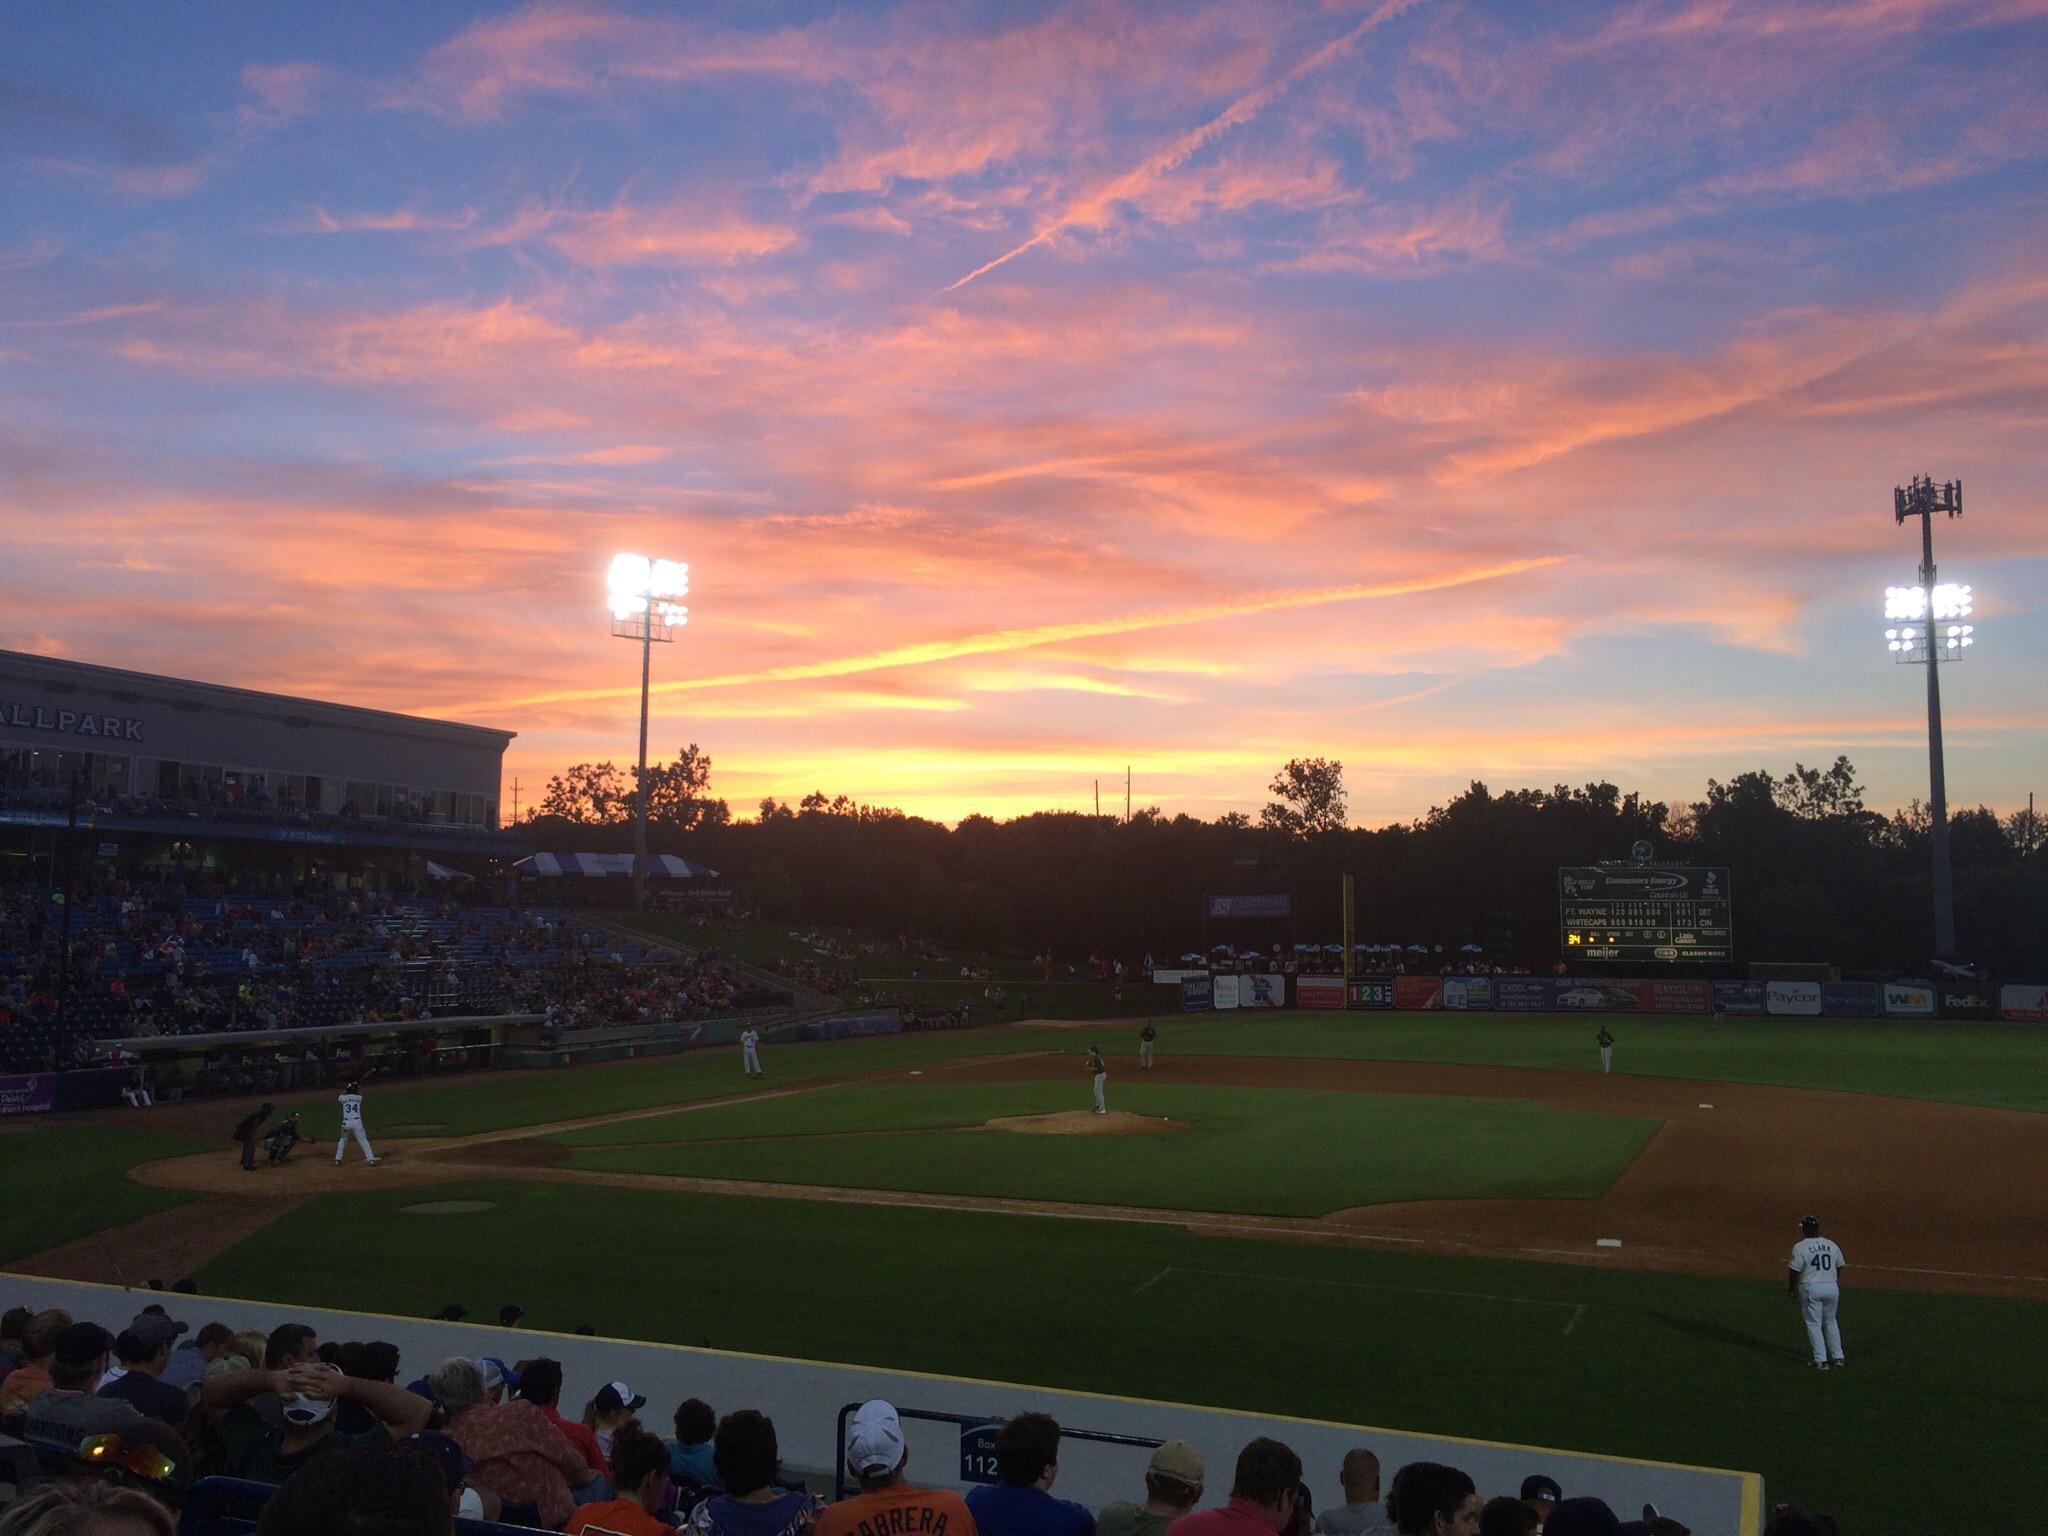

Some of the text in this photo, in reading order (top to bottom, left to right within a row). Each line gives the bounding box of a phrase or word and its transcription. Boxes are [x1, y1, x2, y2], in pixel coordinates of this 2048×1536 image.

[1650, 877, 1678, 887] Energy
[1578, 908, 1607, 916] WAYNE
[1568, 934, 1581, 945] 34
[1586, 947, 1620, 960] meijer
[1768, 990, 1818, 1004] Paycor
[1945, 994, 1989, 1008] FedEx
[345, 1104, 358, 1113] 34
[1811, 1254, 1831, 1270] 40
[977, 1438, 997, 1450] Box
[964, 1454, 998, 1476] 112
[846, 1507, 948, 1536] ABRERA
